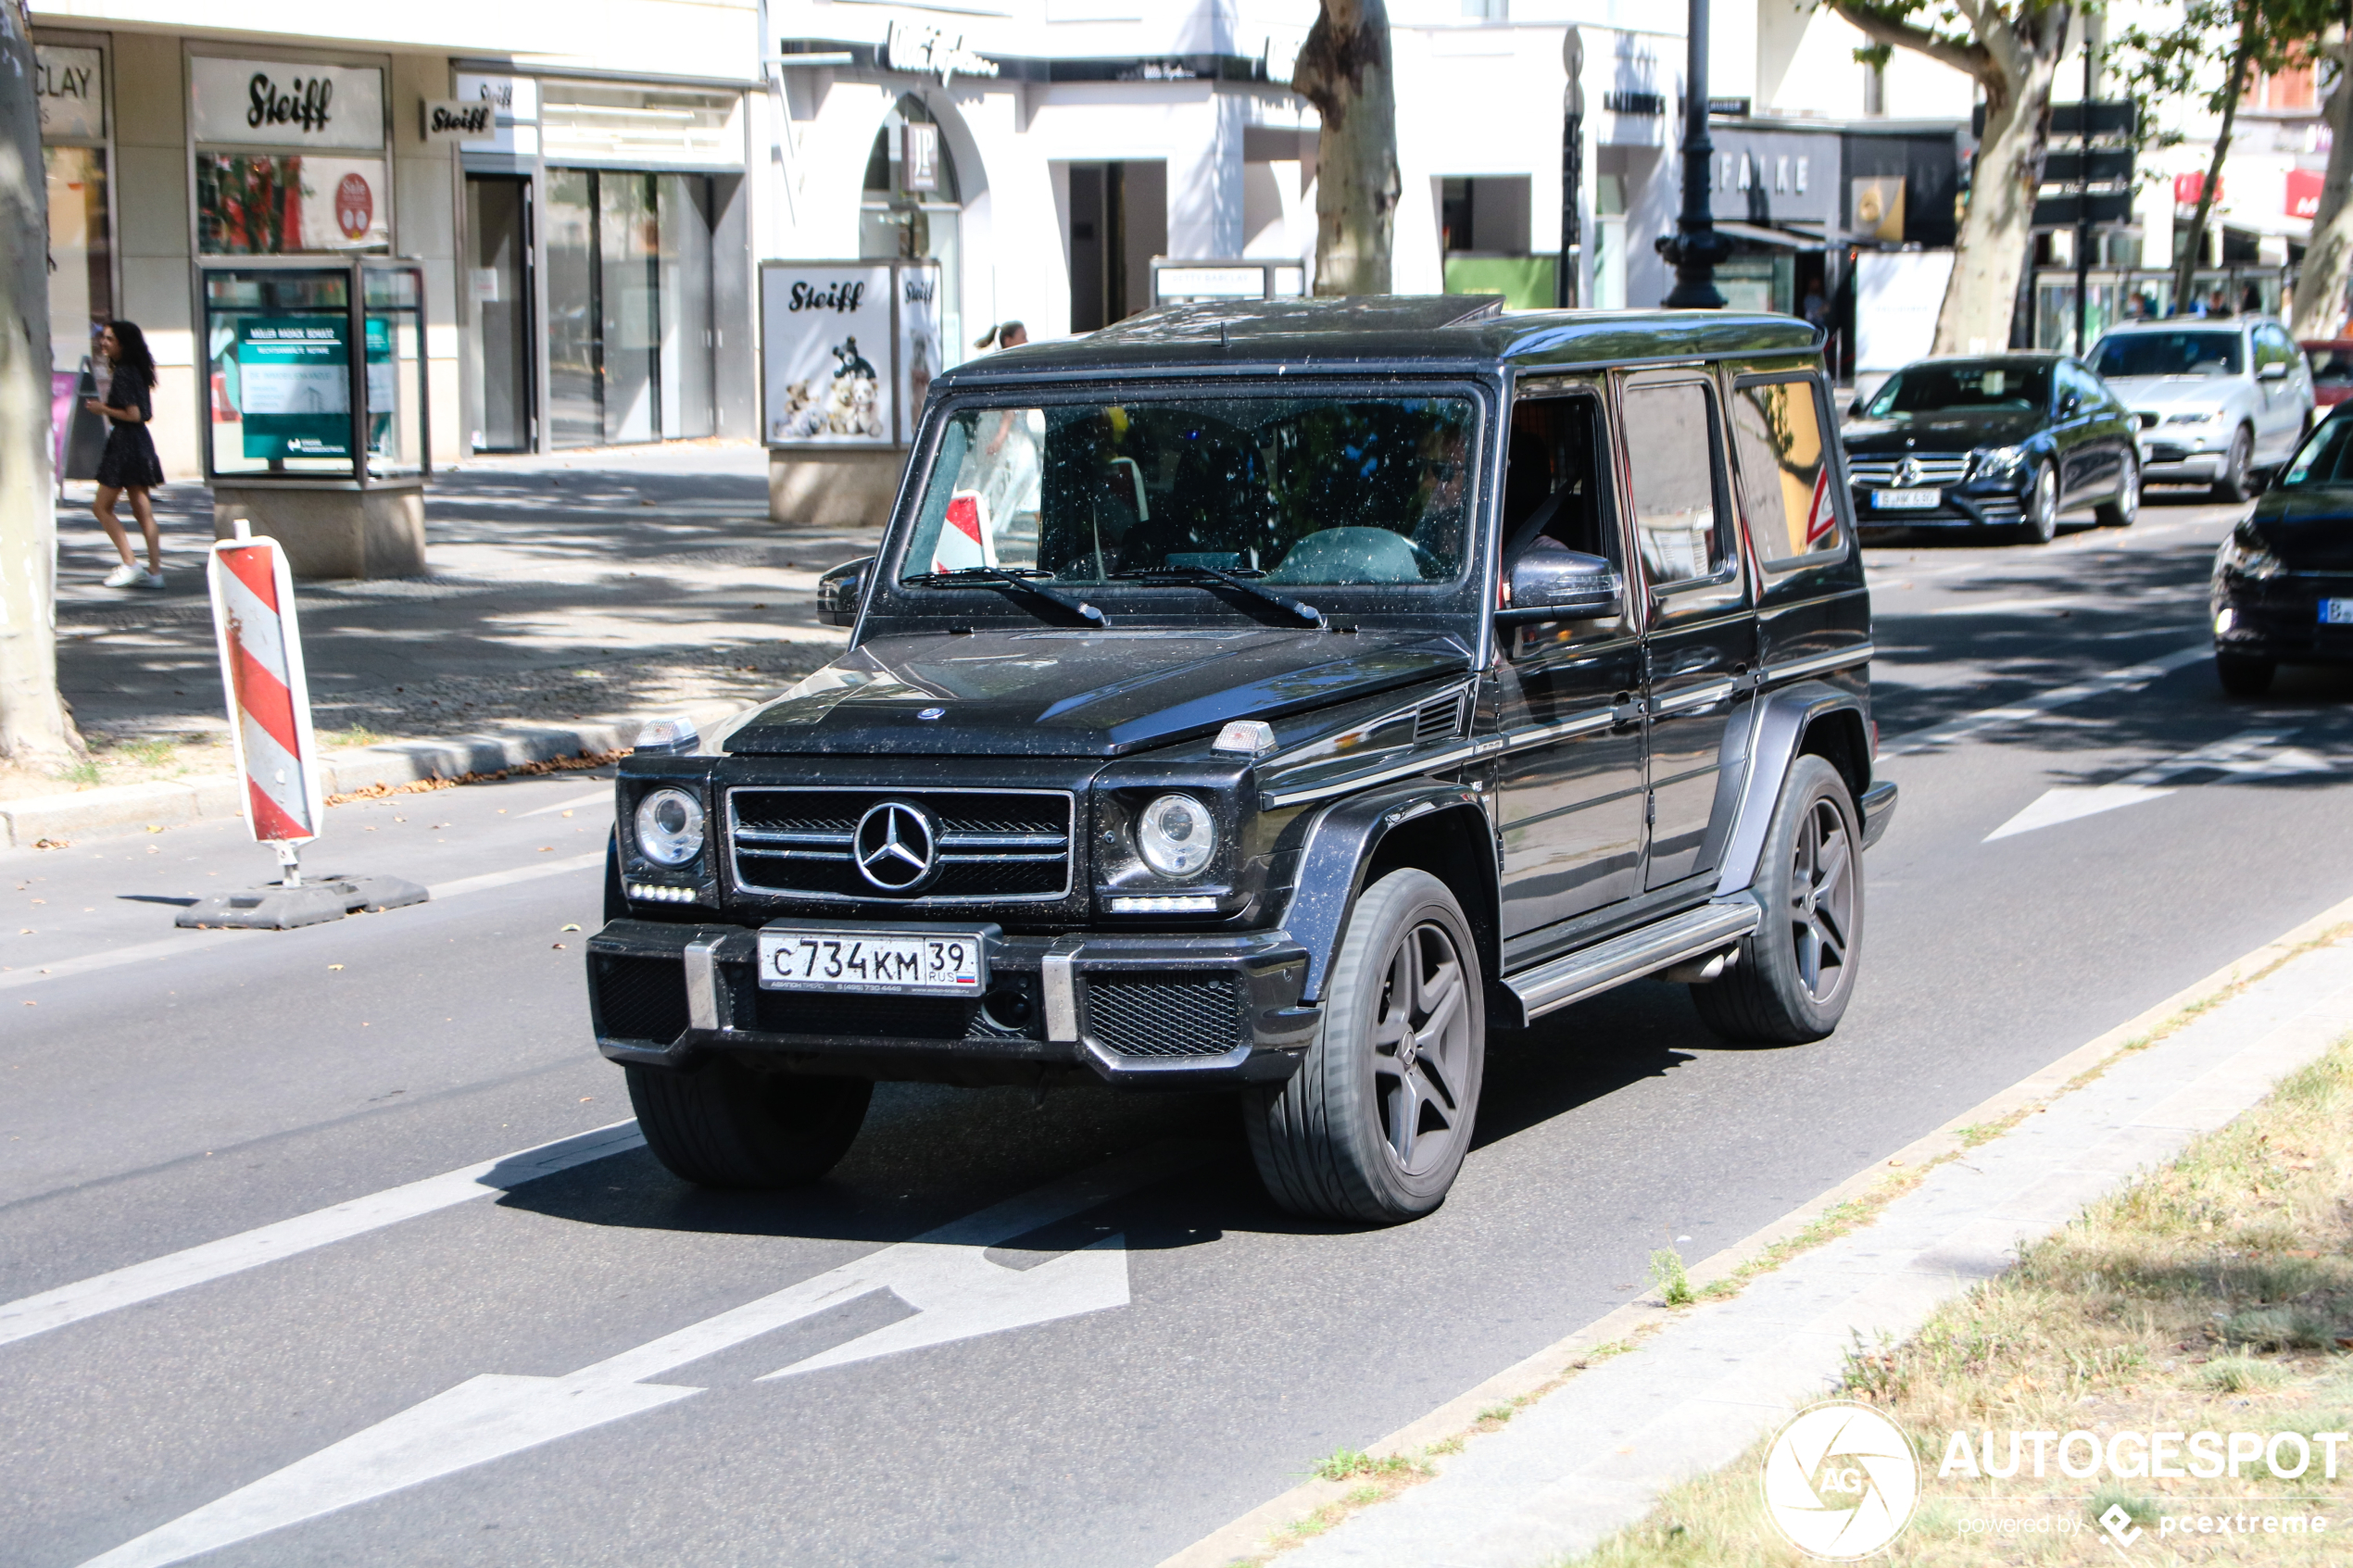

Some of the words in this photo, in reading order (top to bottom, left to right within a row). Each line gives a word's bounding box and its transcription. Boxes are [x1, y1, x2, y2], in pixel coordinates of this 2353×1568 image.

[246, 72, 333, 132] Steiff
[432, 107, 490, 132] Steiff
[1720, 151, 1809, 194] FALKE
[789, 281, 865, 313] Steiff
[906, 281, 935, 306] Steiff
[929, 942, 964, 972] 39
[929, 972, 955, 982] RUS
